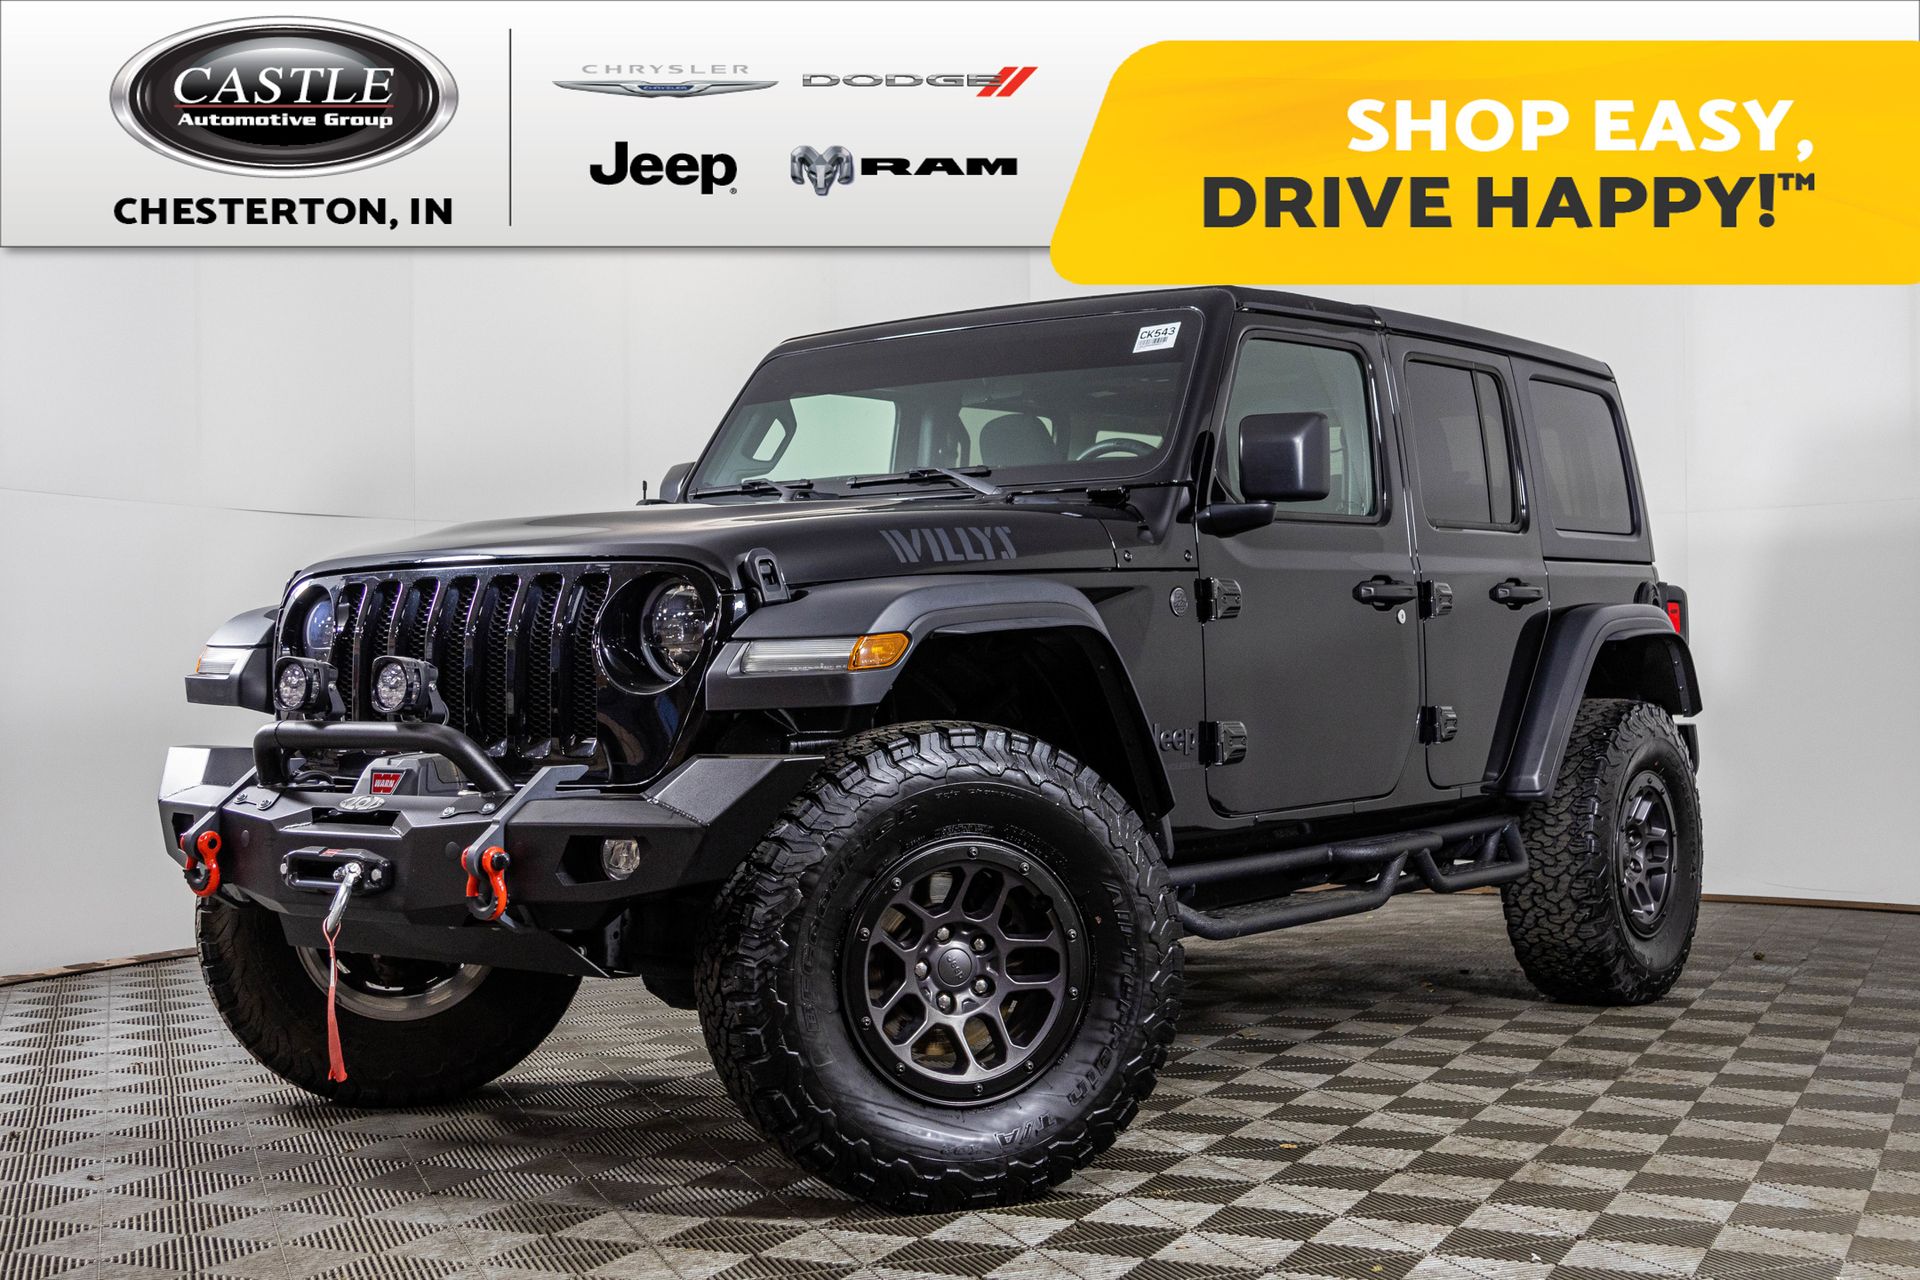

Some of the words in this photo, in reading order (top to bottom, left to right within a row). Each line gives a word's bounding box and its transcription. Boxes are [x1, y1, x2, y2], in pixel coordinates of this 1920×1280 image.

[1140, 327, 1176, 340] CK543
[879, 526, 1017, 563] WILLYS
[374, 779, 395, 788] WARN
[993, 1111, 1058, 1150] T/A
